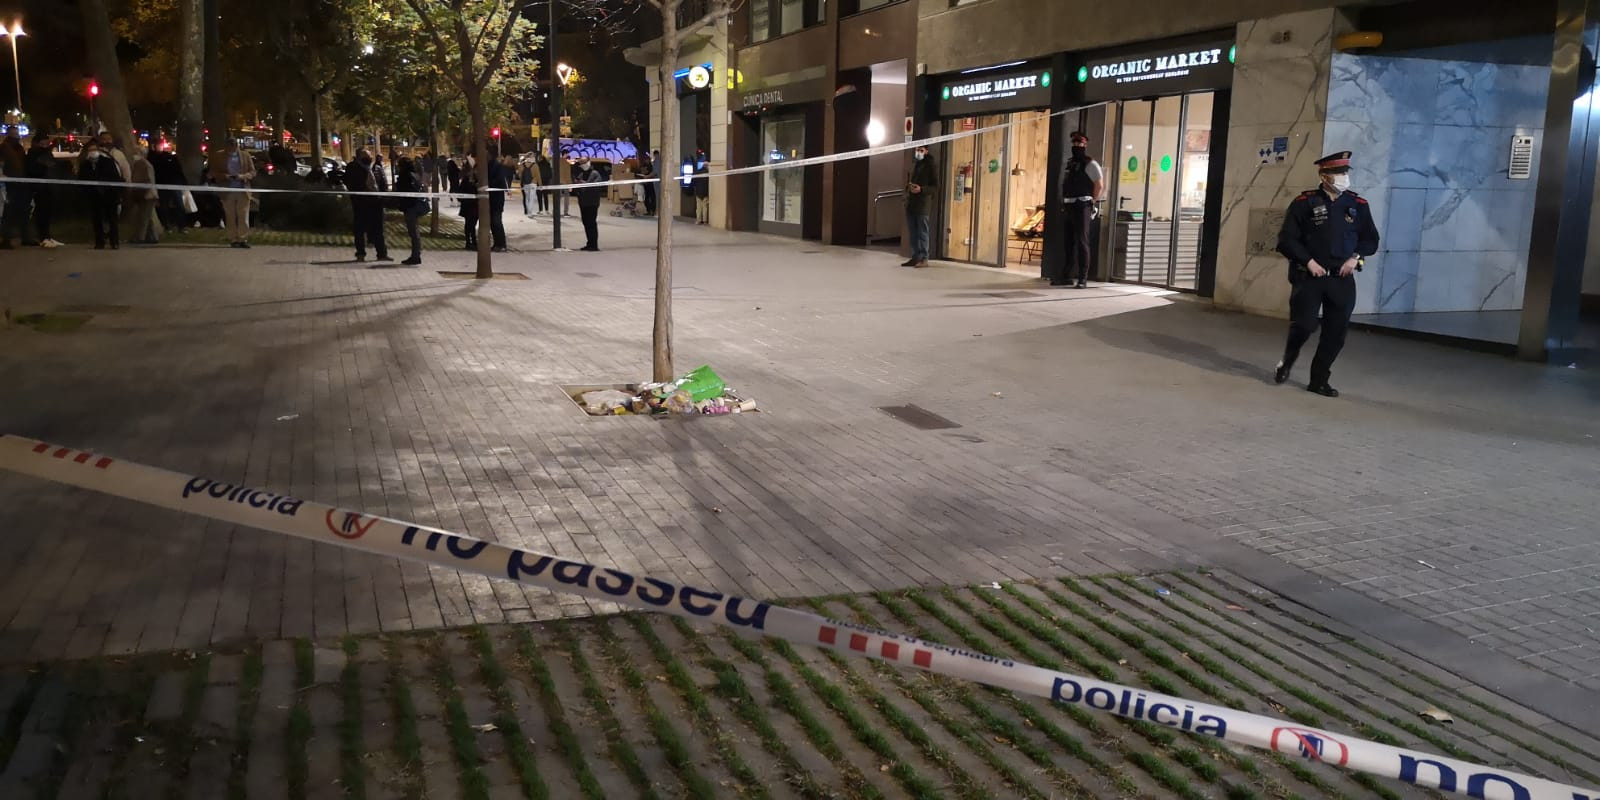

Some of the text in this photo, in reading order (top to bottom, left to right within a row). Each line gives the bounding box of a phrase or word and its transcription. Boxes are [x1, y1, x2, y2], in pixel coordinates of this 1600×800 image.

[1092, 59, 1152, 79] ORGANIC
[1155, 49, 1221, 71] MARKET
[763, 89, 784, 103] DENTAL
[952, 82, 992, 97] ORGANIC
[994, 75, 1037, 92] MARKET
[507, 548, 772, 631] passeu
[1050, 676, 1532, 800] policia no
